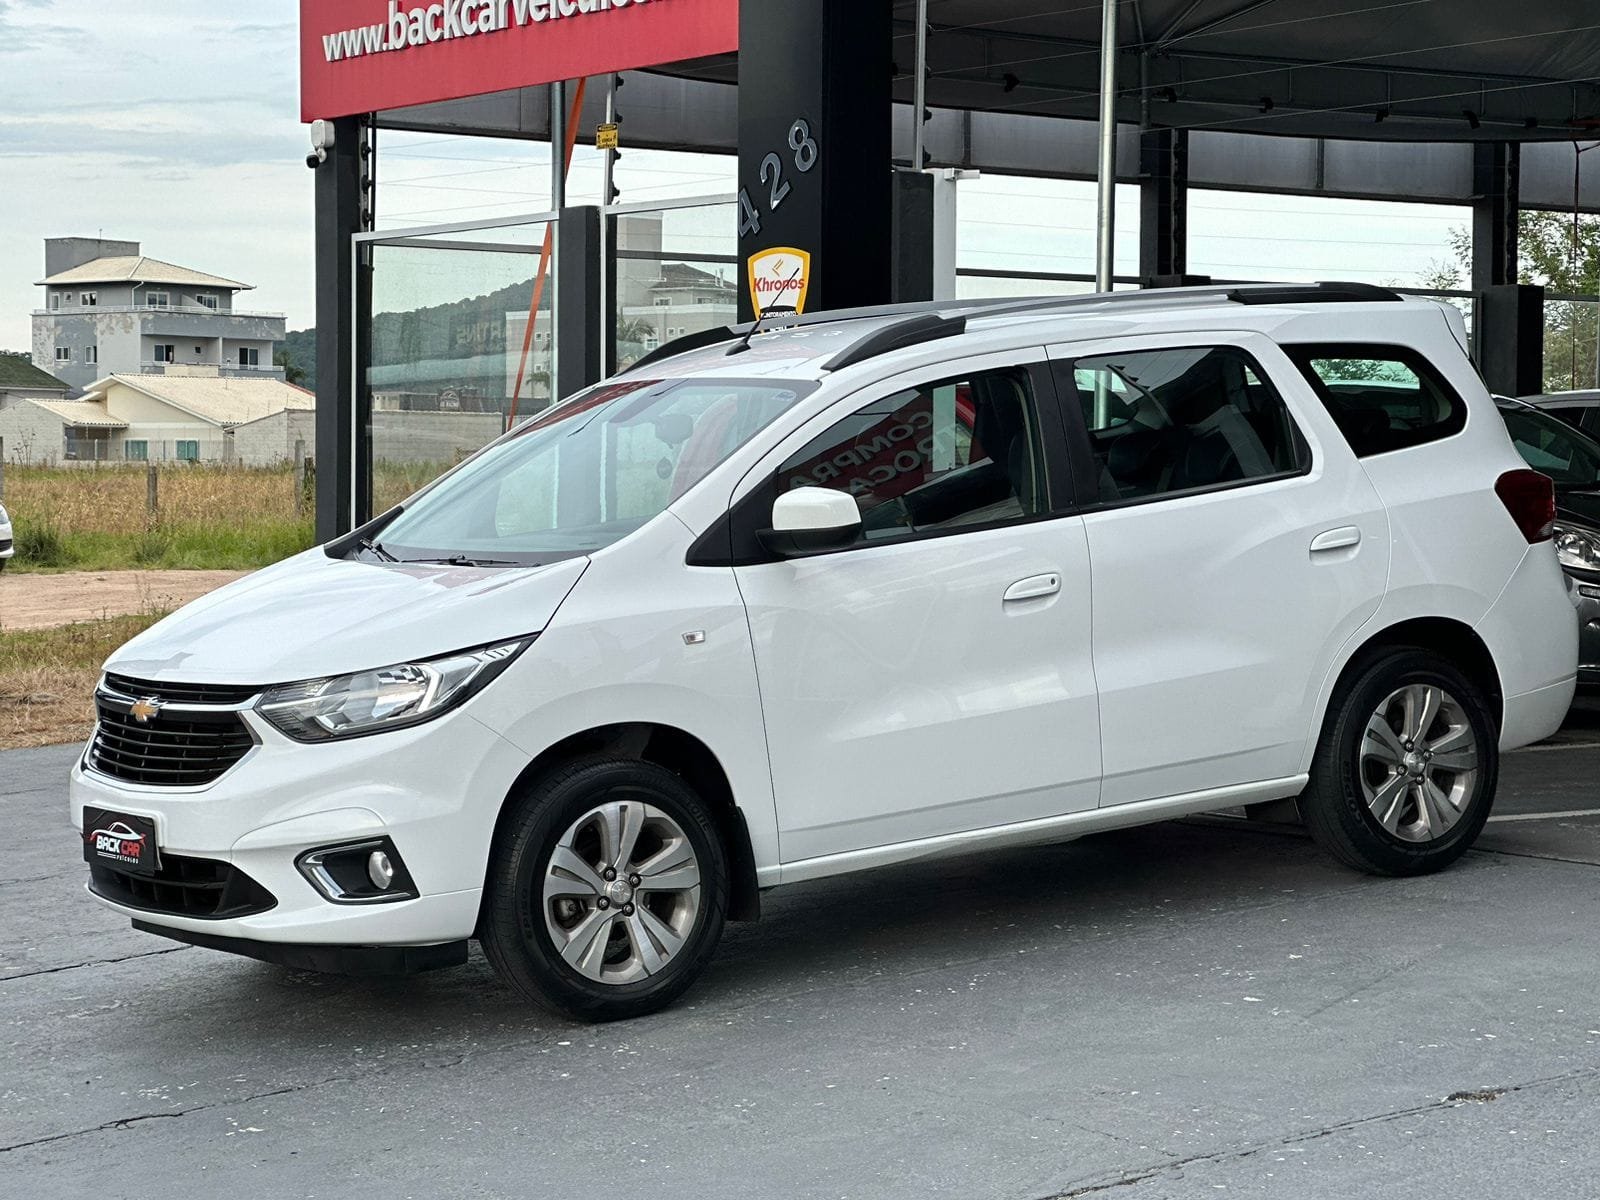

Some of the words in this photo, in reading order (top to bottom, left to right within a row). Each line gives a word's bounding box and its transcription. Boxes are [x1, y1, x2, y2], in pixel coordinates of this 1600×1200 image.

[753, 277, 805, 293] Khronos
[96, 835, 121, 854] BACK
[121, 840, 140, 858] CAR
